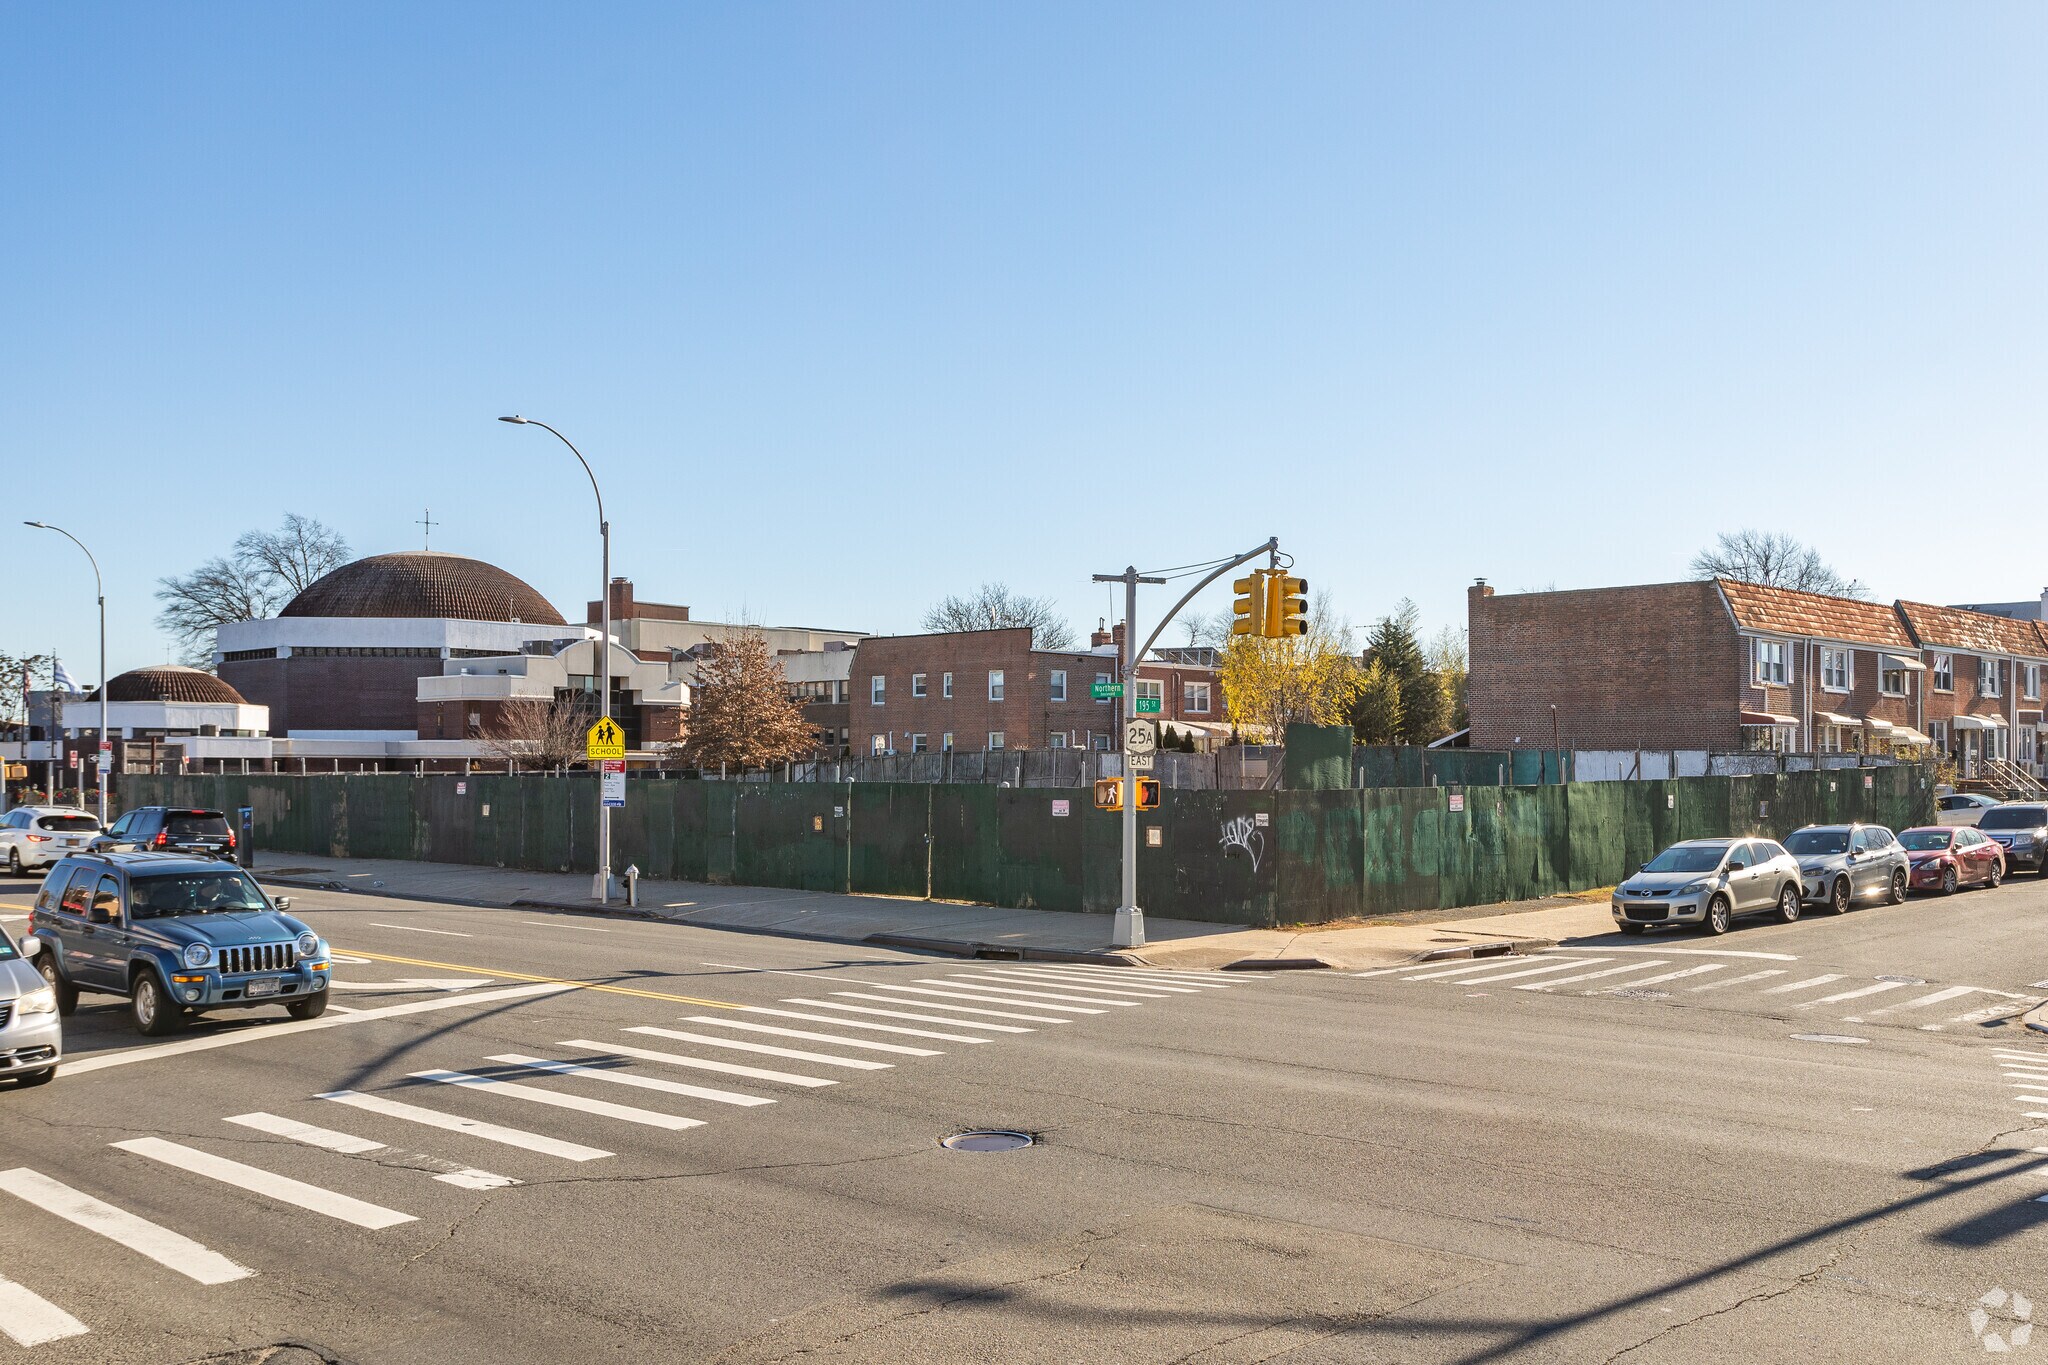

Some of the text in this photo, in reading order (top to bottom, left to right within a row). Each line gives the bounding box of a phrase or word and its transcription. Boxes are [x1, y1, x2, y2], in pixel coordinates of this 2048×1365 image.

[1139, 701, 1149, 710] 195
[1129, 728, 1153, 744] 25A
[1131, 756, 1150, 765] EAST
